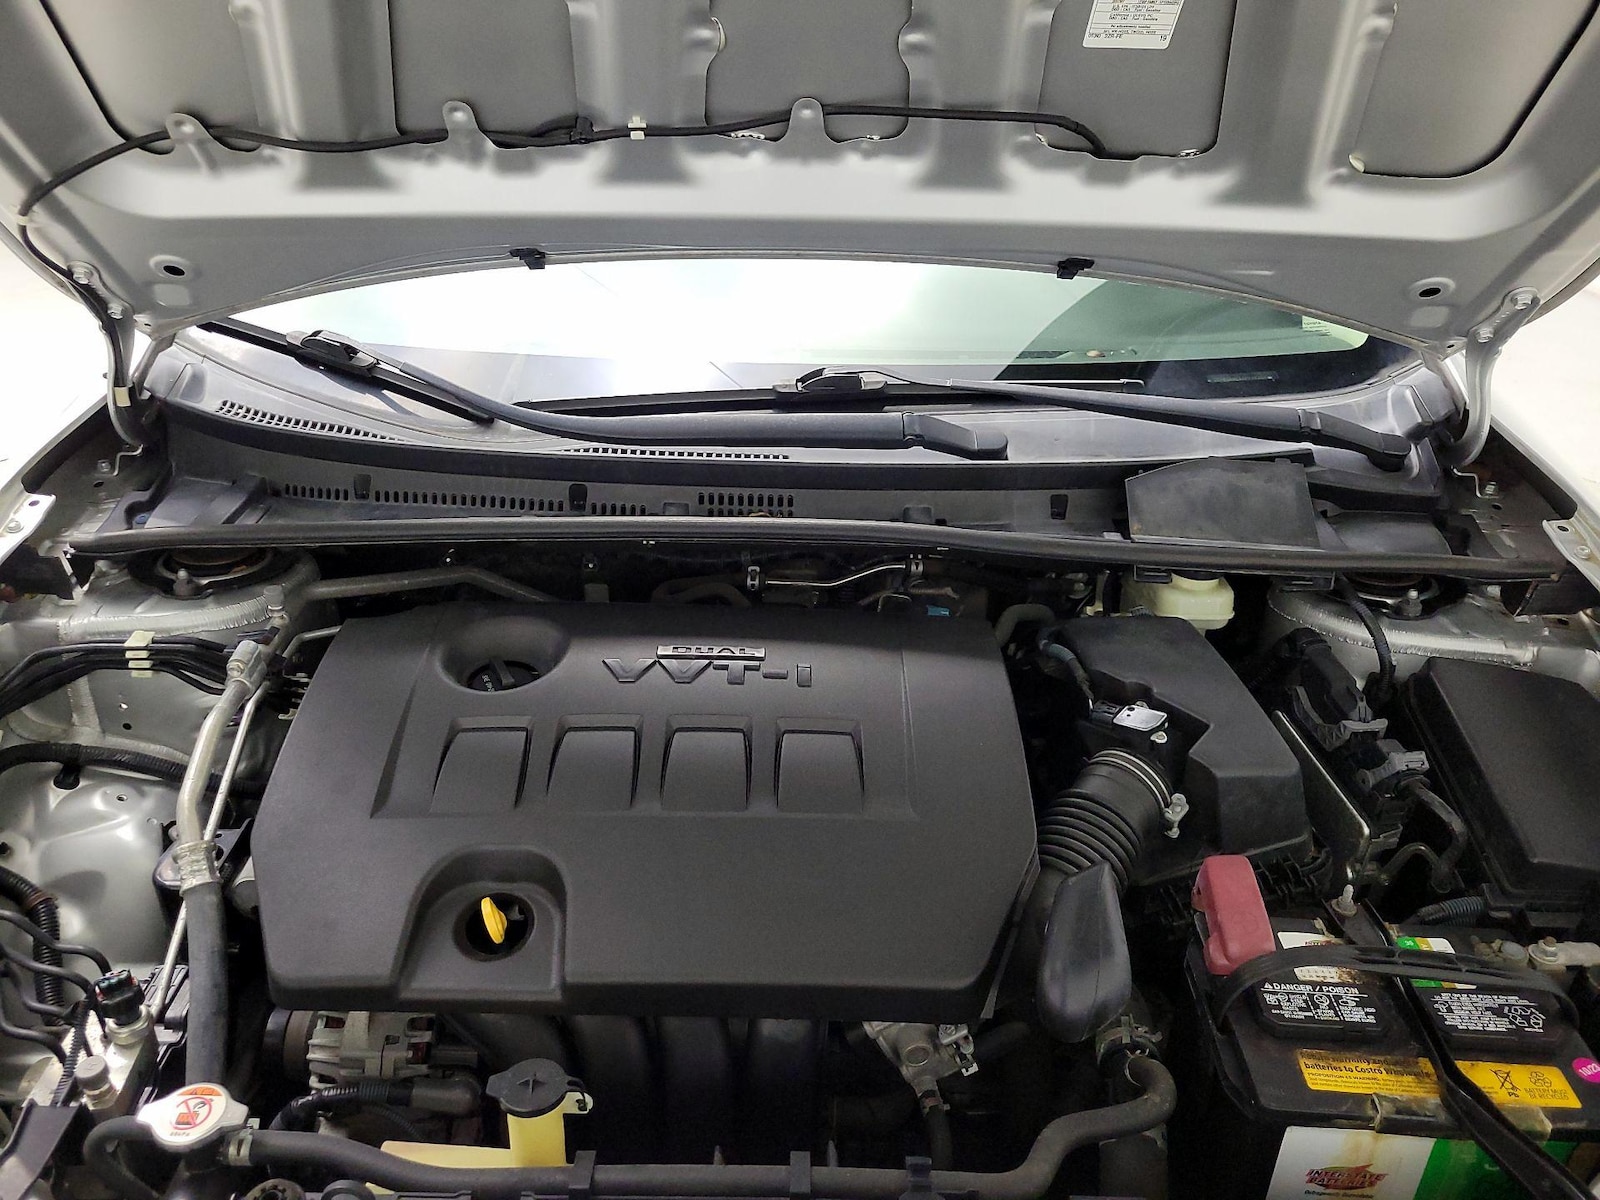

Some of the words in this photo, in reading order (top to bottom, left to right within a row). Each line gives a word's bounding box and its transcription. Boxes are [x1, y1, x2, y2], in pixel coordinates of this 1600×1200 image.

[671, 646, 757, 656] DUAL
[1273, 983, 1314, 992] DANGER
[1322, 986, 1359, 994] POISON
[1303, 1061, 1343, 1072] batteries
[1343, 1065, 1354, 1073] to
